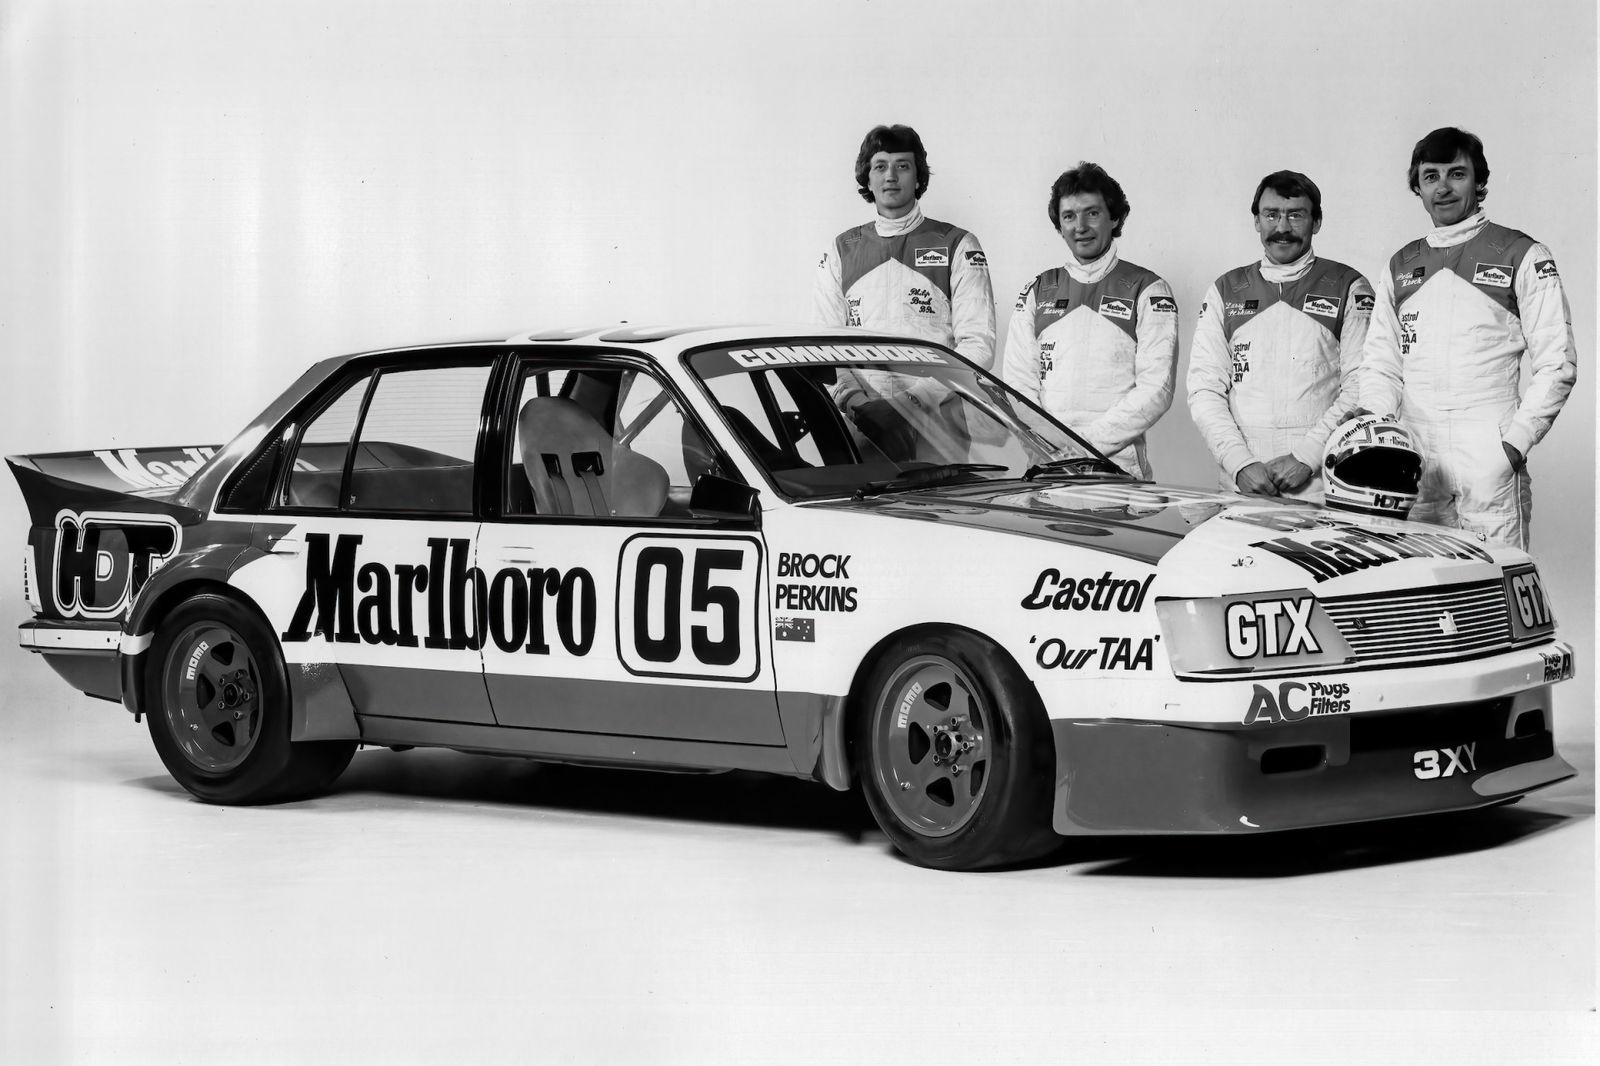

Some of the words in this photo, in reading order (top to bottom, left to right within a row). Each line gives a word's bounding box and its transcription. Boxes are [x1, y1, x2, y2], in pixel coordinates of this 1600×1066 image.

[1482, 271, 1506, 280] Marlboro
[1311, 301, 1333, 310] Marlboro
[1401, 333, 1417, 344] TAA
[728, 344, 949, 368] COMMODORE
[1233, 363, 1250, 373] TAA
[1373, 494, 1405, 510] HDT
[54, 510, 182, 617] HDT
[777, 552, 851, 579] BROCK
[1248, 526, 1494, 583] Marlboro
[281, 532, 597, 656] Marlboro
[775, 583, 858, 613] PERKINS
[1020, 568, 1158, 613] Castrol
[1511, 571, 1553, 629] GTX
[633, 546, 744, 666] 05
[1225, 597, 1322, 660] GTX
[1242, 681, 1310, 726] AC
[1309, 681, 1351, 699] Plugs
[1309, 696, 1351, 716] Filters
[1413, 741, 1477, 780] 3XY
